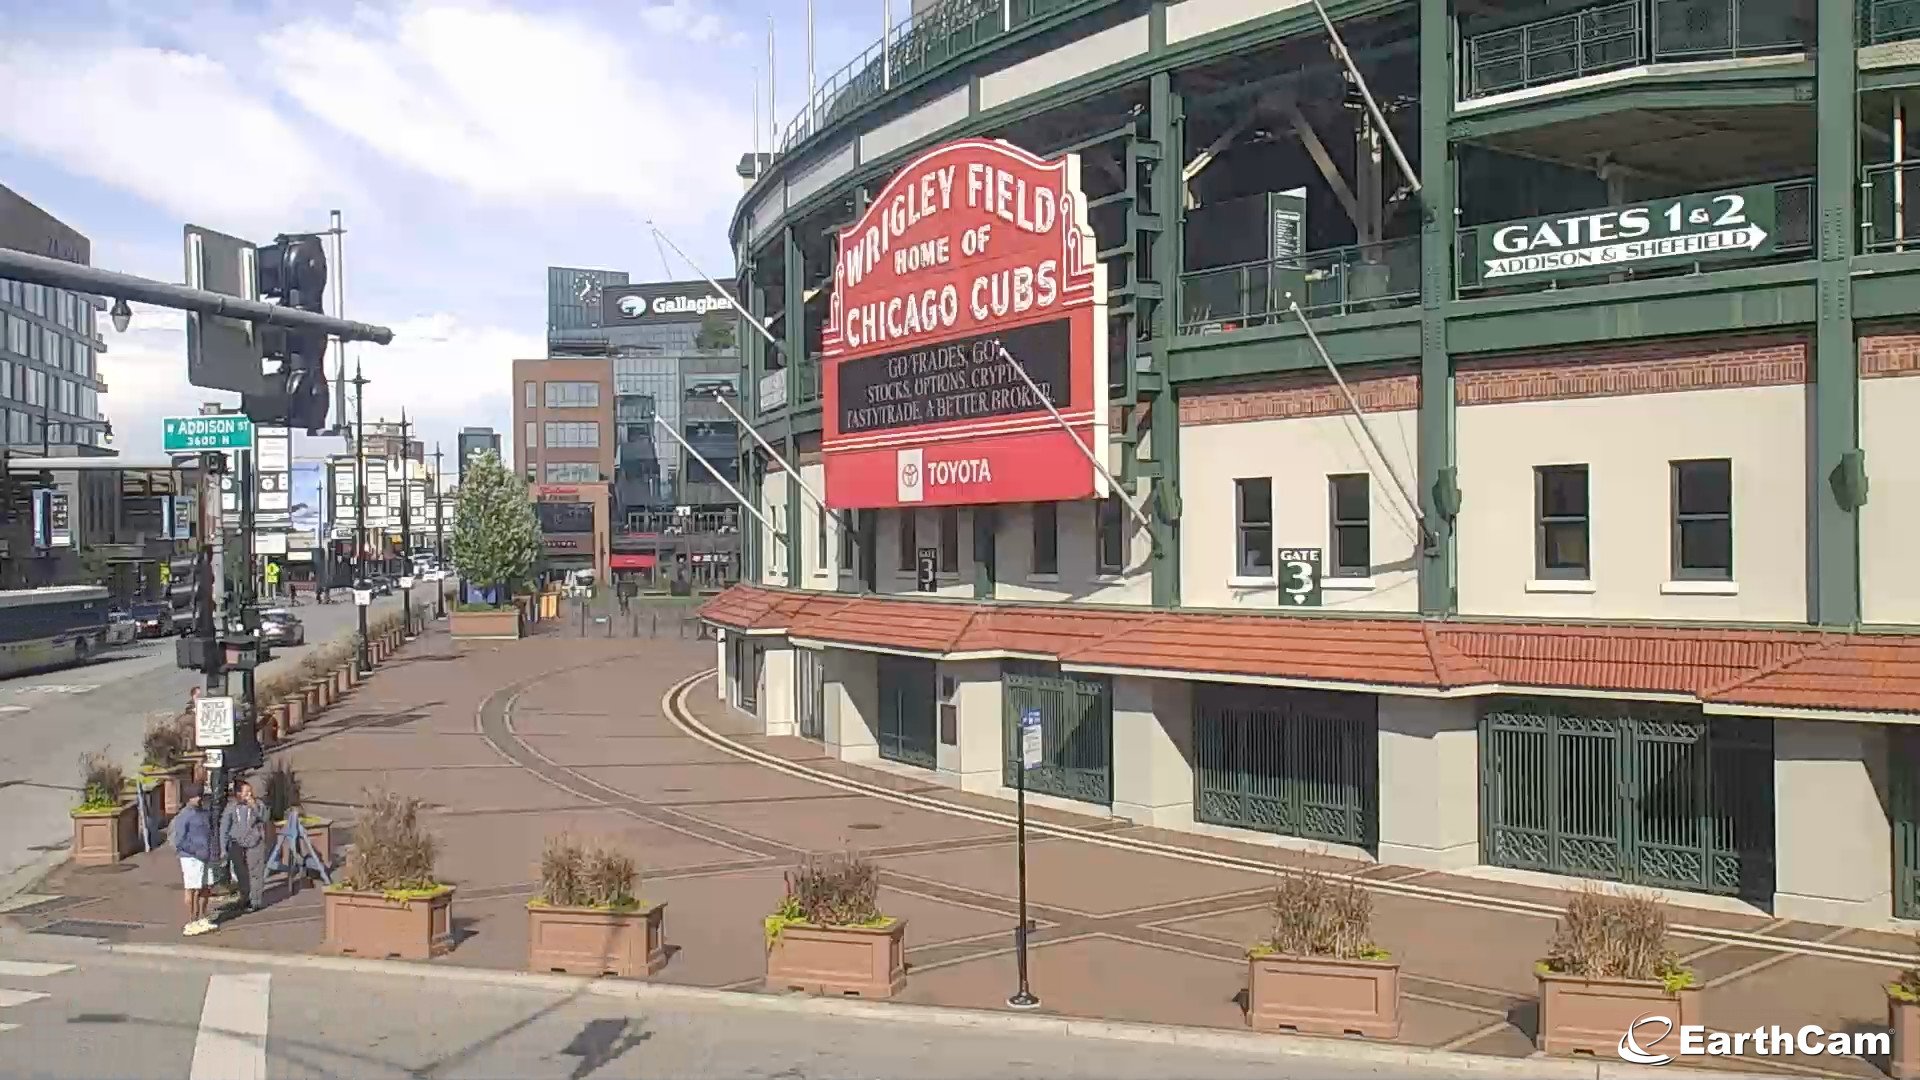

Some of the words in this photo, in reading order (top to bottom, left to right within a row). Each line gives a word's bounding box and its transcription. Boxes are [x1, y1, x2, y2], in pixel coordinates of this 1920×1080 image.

[845, 164, 956, 287] WRIGLEY
[967, 163, 1056, 233] FIELD
[1493, 207, 1650, 254] GATES
[894, 236, 951, 274] HOME
[961, 224, 991, 257] OF
[1495, 252, 1592, 273] ADDISON
[1600, 247, 1617, 262] &
[1625, 228, 1751, 259] SHEFFIELD
[846, 283, 958, 348] CHICAGO
[970, 259, 1057, 321] CUBS
[888, 356, 908, 379] GO
[926, 402, 935, 418] A
[936, 391, 990, 418] BETTER
[177, 419, 235, 435] ADDISON
[237, 420, 248, 431] ST
[188, 436, 216, 446] 3600
[927, 458, 992, 486] TOYOTA
[1280, 550, 1319, 561] GATE
[922, 559, 933, 583] 3
[1286, 561, 1313, 594] 3
